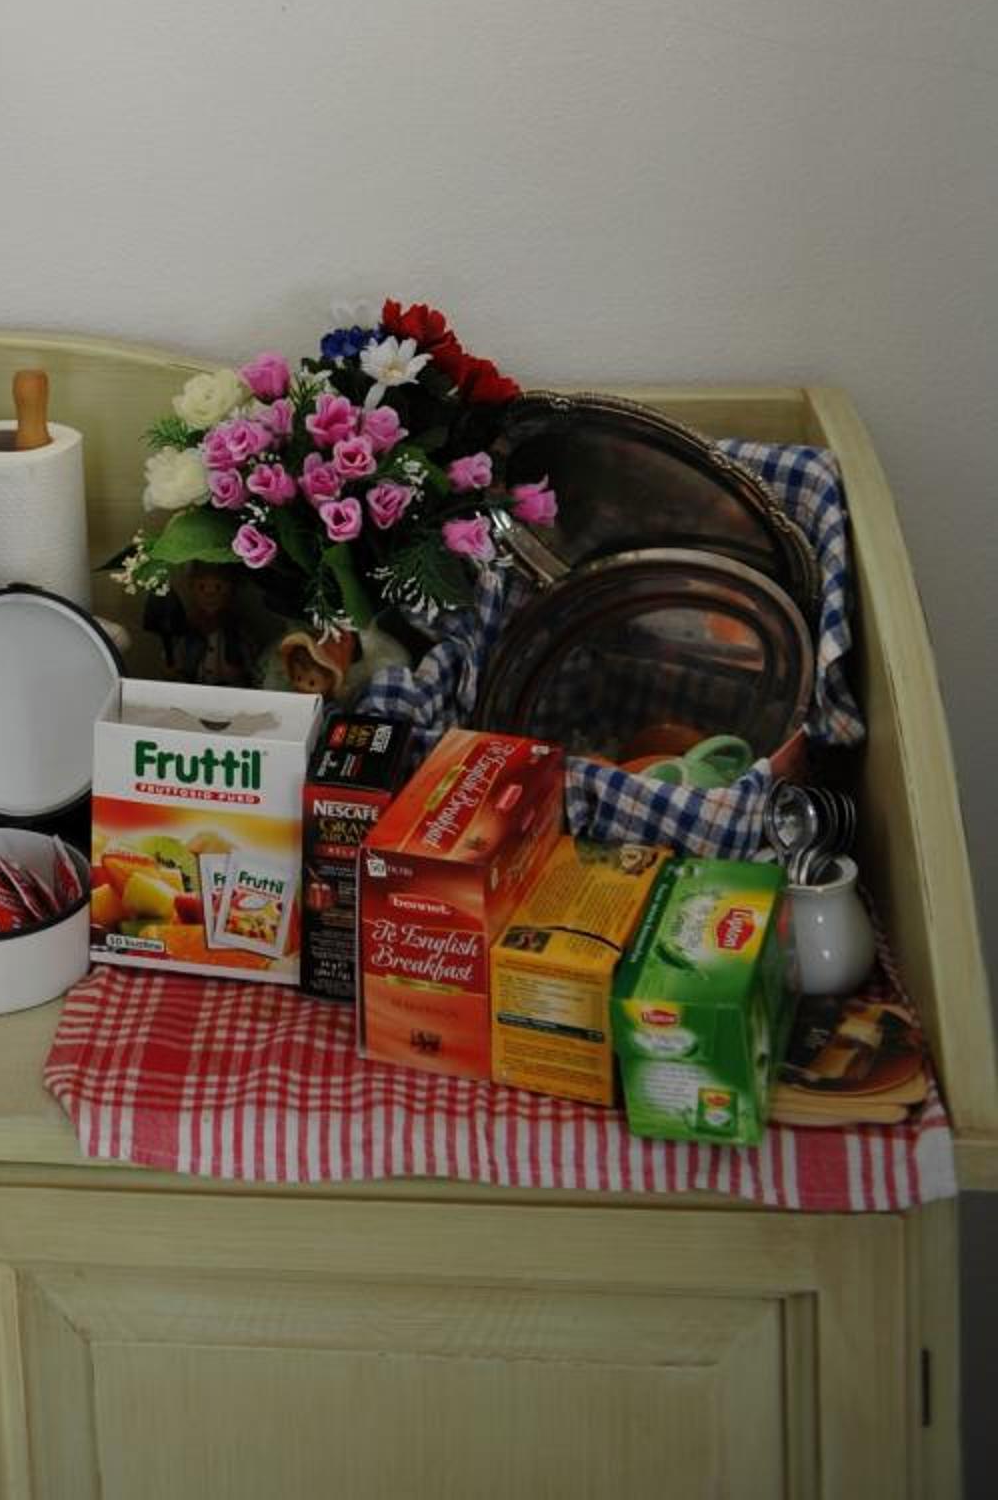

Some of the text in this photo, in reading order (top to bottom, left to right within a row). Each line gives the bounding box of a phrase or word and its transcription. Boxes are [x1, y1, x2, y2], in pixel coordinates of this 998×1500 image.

[133, 740, 262, 790] Fruttil
[239, 870, 285, 894] Fruttil
[400, 923, 479, 959] English
[370, 942, 475, 981] Breakfast
